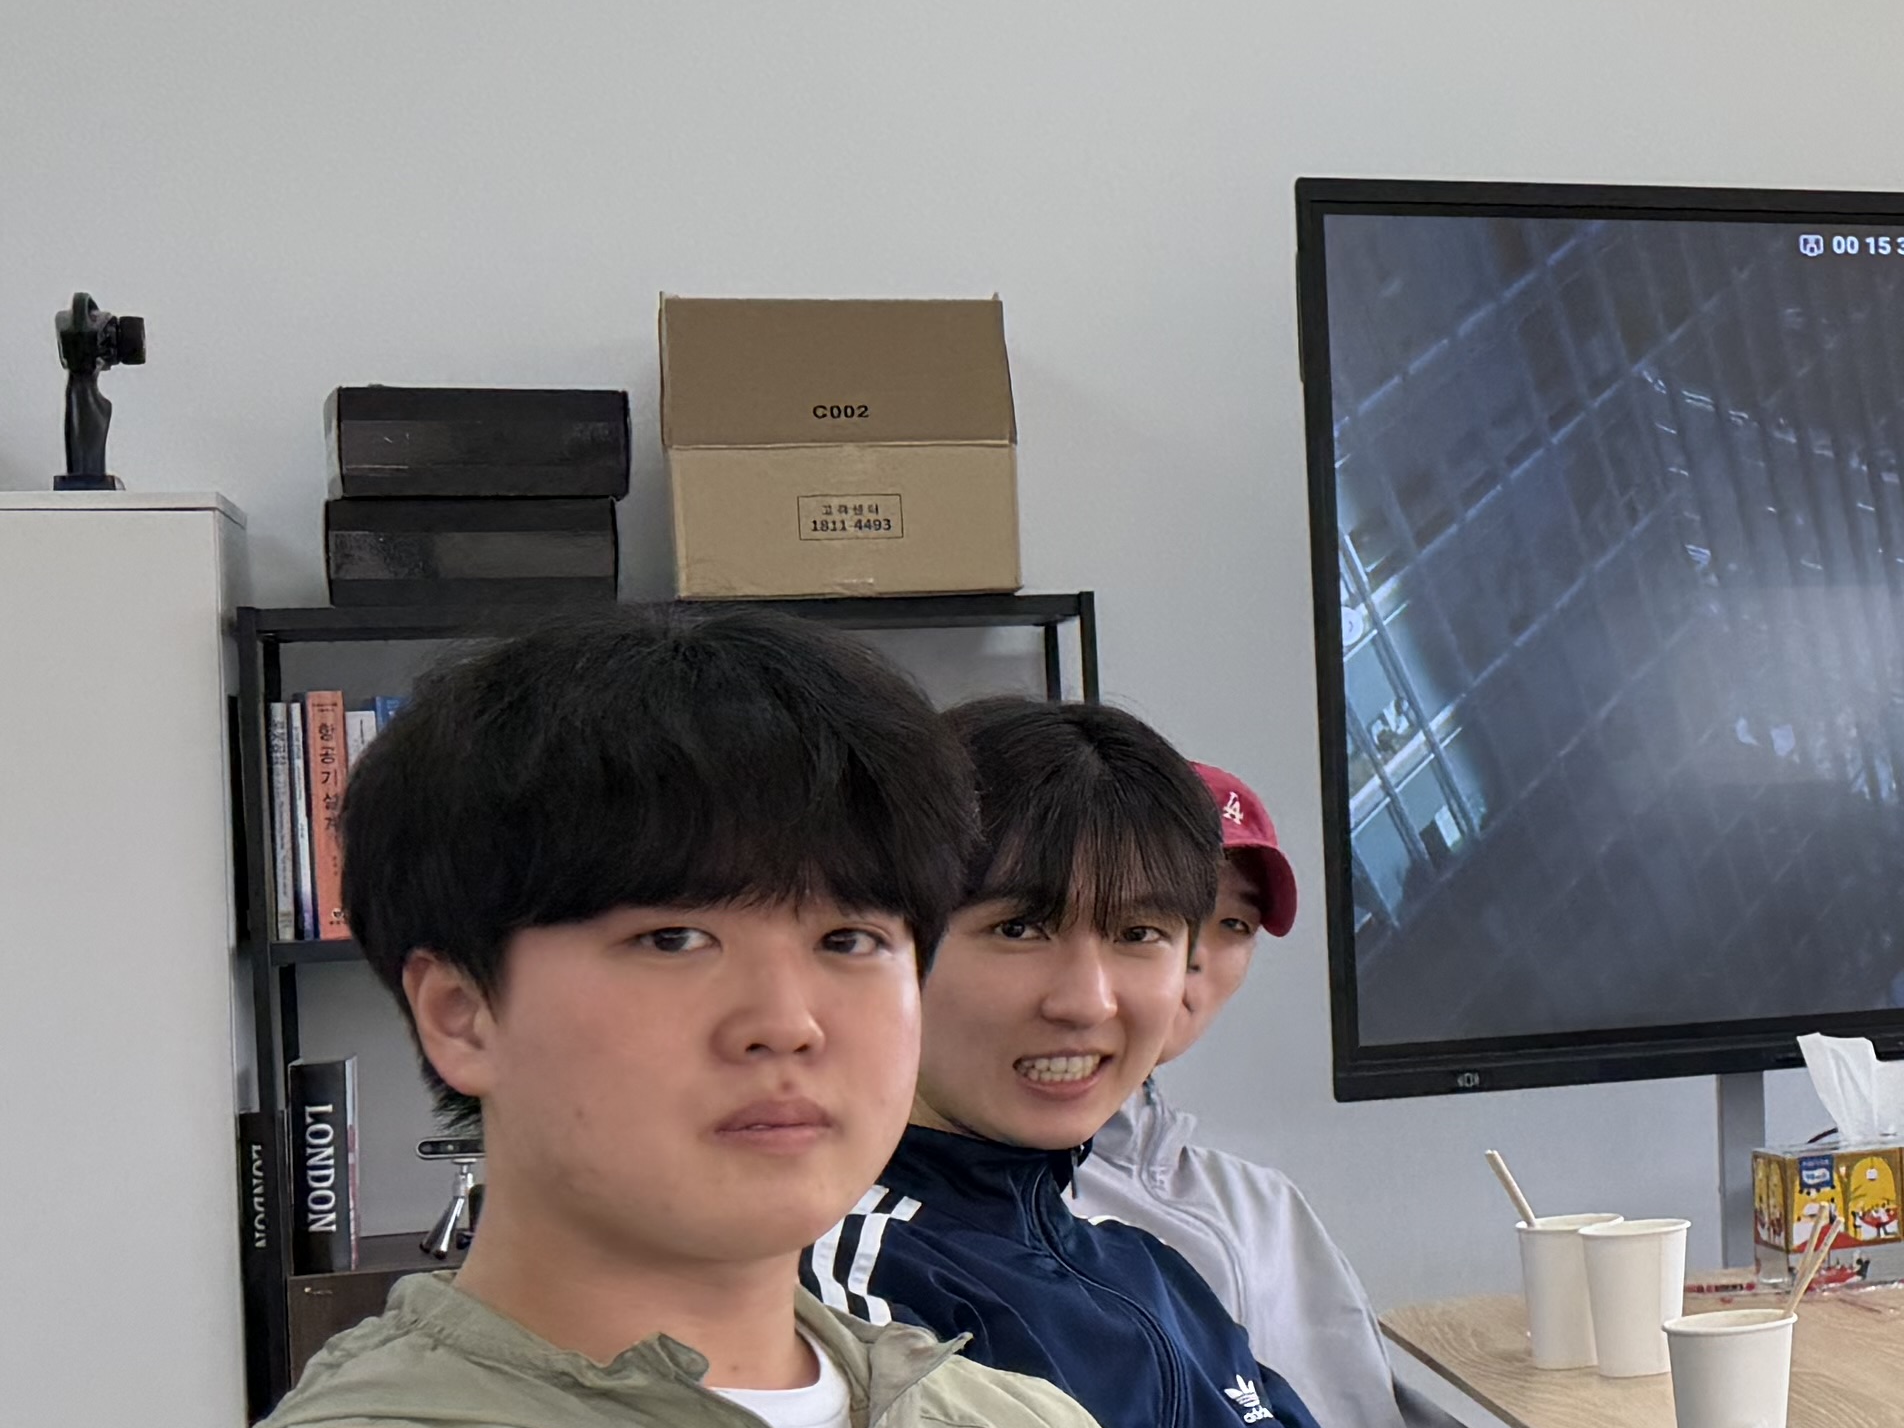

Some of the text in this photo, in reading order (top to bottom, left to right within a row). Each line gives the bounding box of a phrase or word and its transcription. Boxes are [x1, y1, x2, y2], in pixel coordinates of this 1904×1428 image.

[1832, 236, 1859, 254] 00
[1865, 236, 1892, 255] 15
[812, 405, 870, 419] C002
[1222, 791, 1244, 825] LA
[304, 1103, 337, 1233] LONDON
